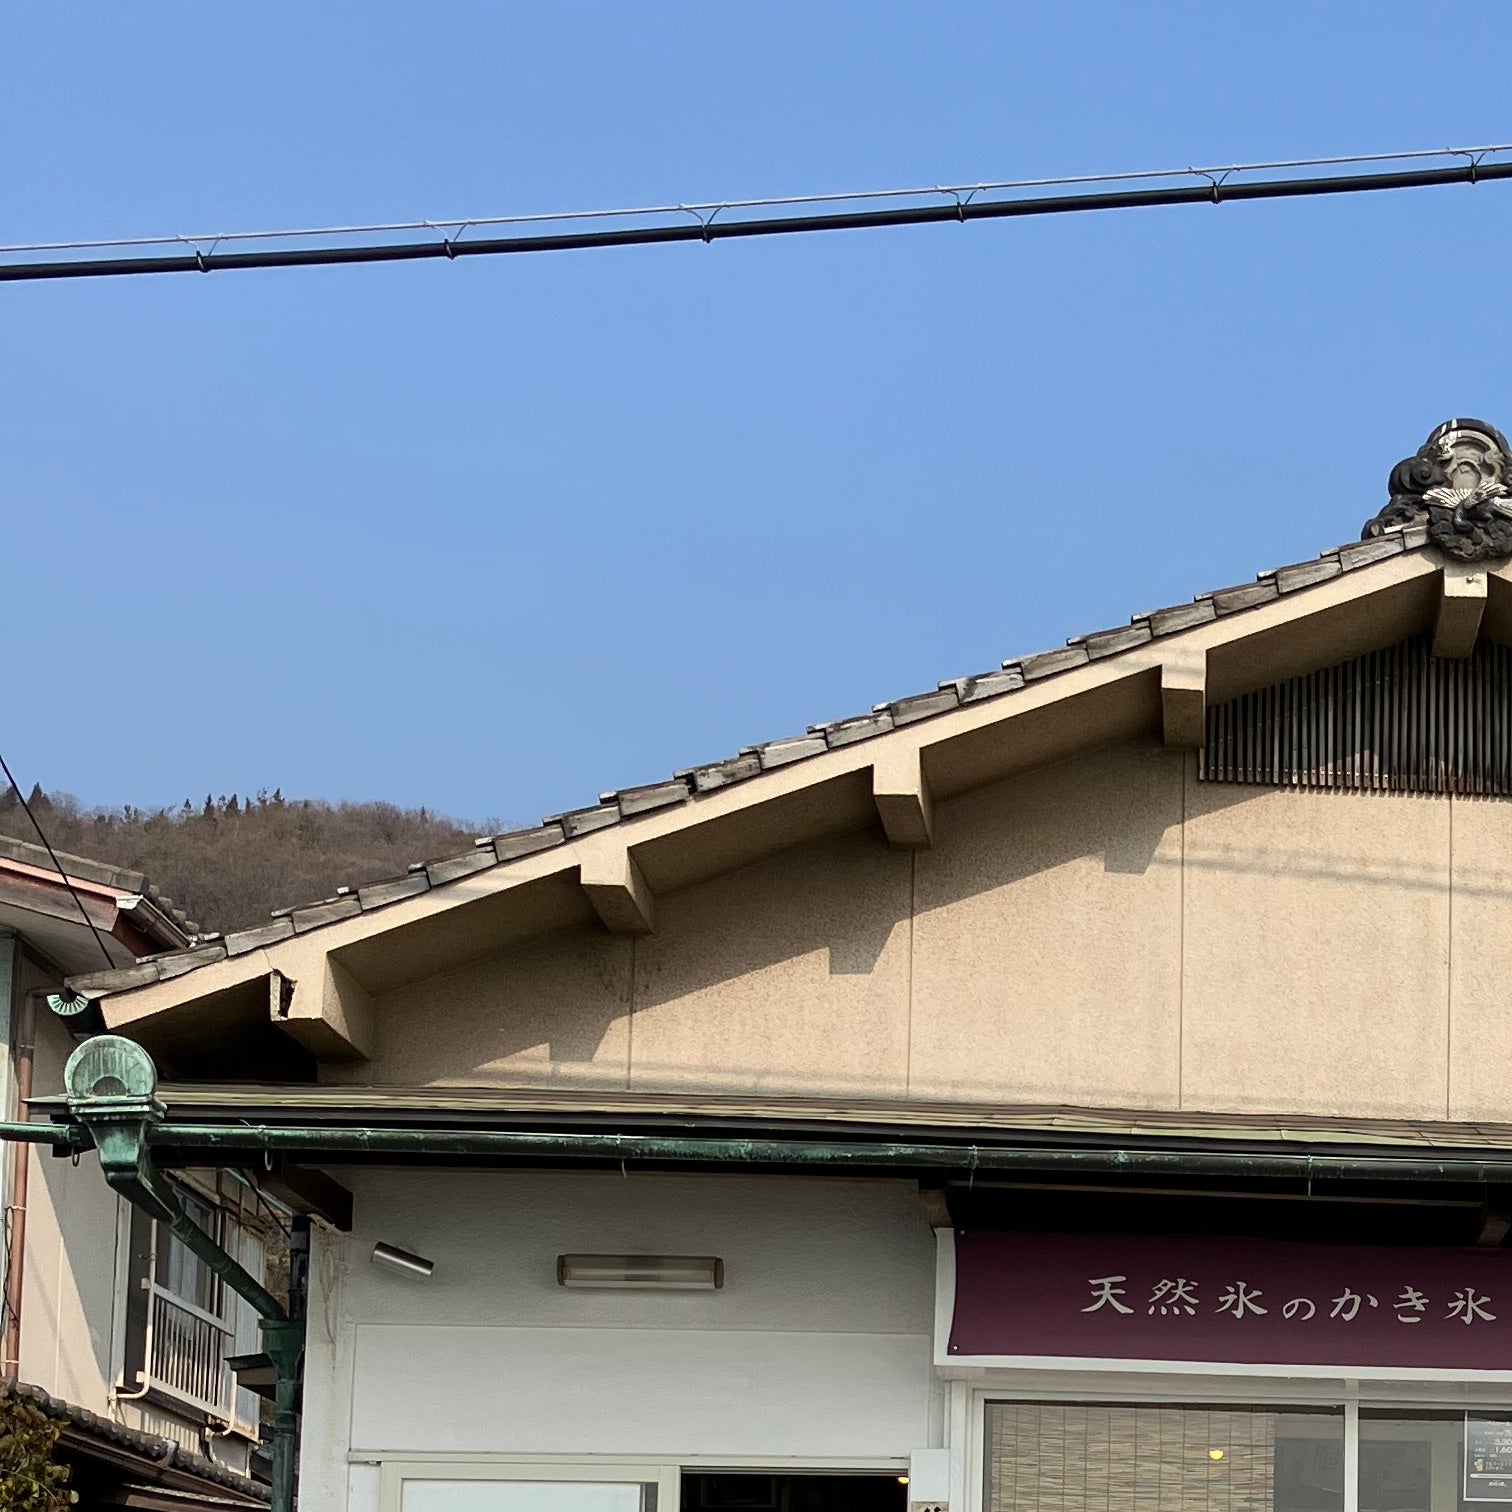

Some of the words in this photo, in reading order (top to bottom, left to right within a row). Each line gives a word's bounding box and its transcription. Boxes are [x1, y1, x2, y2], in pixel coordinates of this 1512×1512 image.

[1080, 1274, 1498, 1326] 天然氷のかき氷
